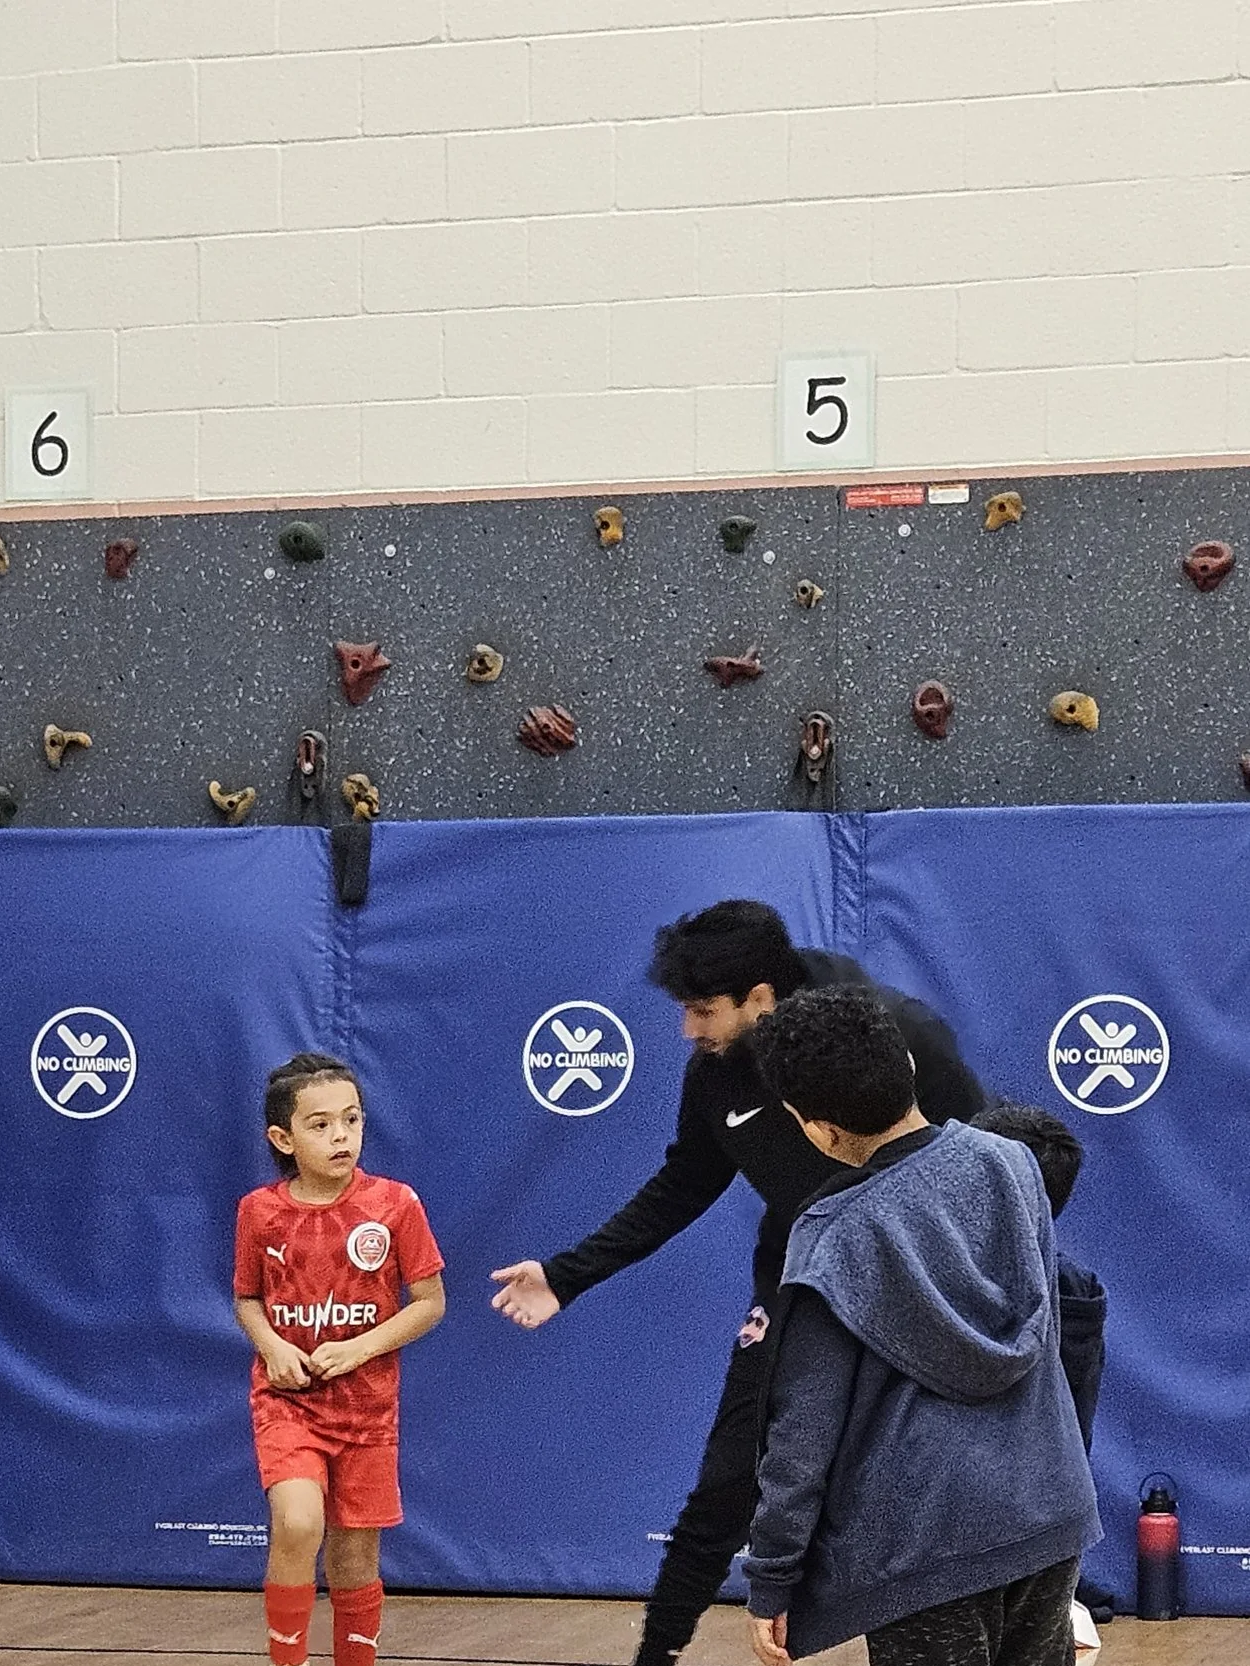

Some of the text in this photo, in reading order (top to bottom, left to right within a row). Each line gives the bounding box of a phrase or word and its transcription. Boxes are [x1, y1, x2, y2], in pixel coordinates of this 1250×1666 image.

[806, 376, 848, 445] 5
[31, 411, 69, 476] 6
[37, 1056, 131, 1072] NO CLIMBING
[530, 1052, 628, 1068] NO CLIMBING
[1055, 1048, 1163, 1065] NO CLIMBING
[271, 1289, 378, 1341] THUNDER
